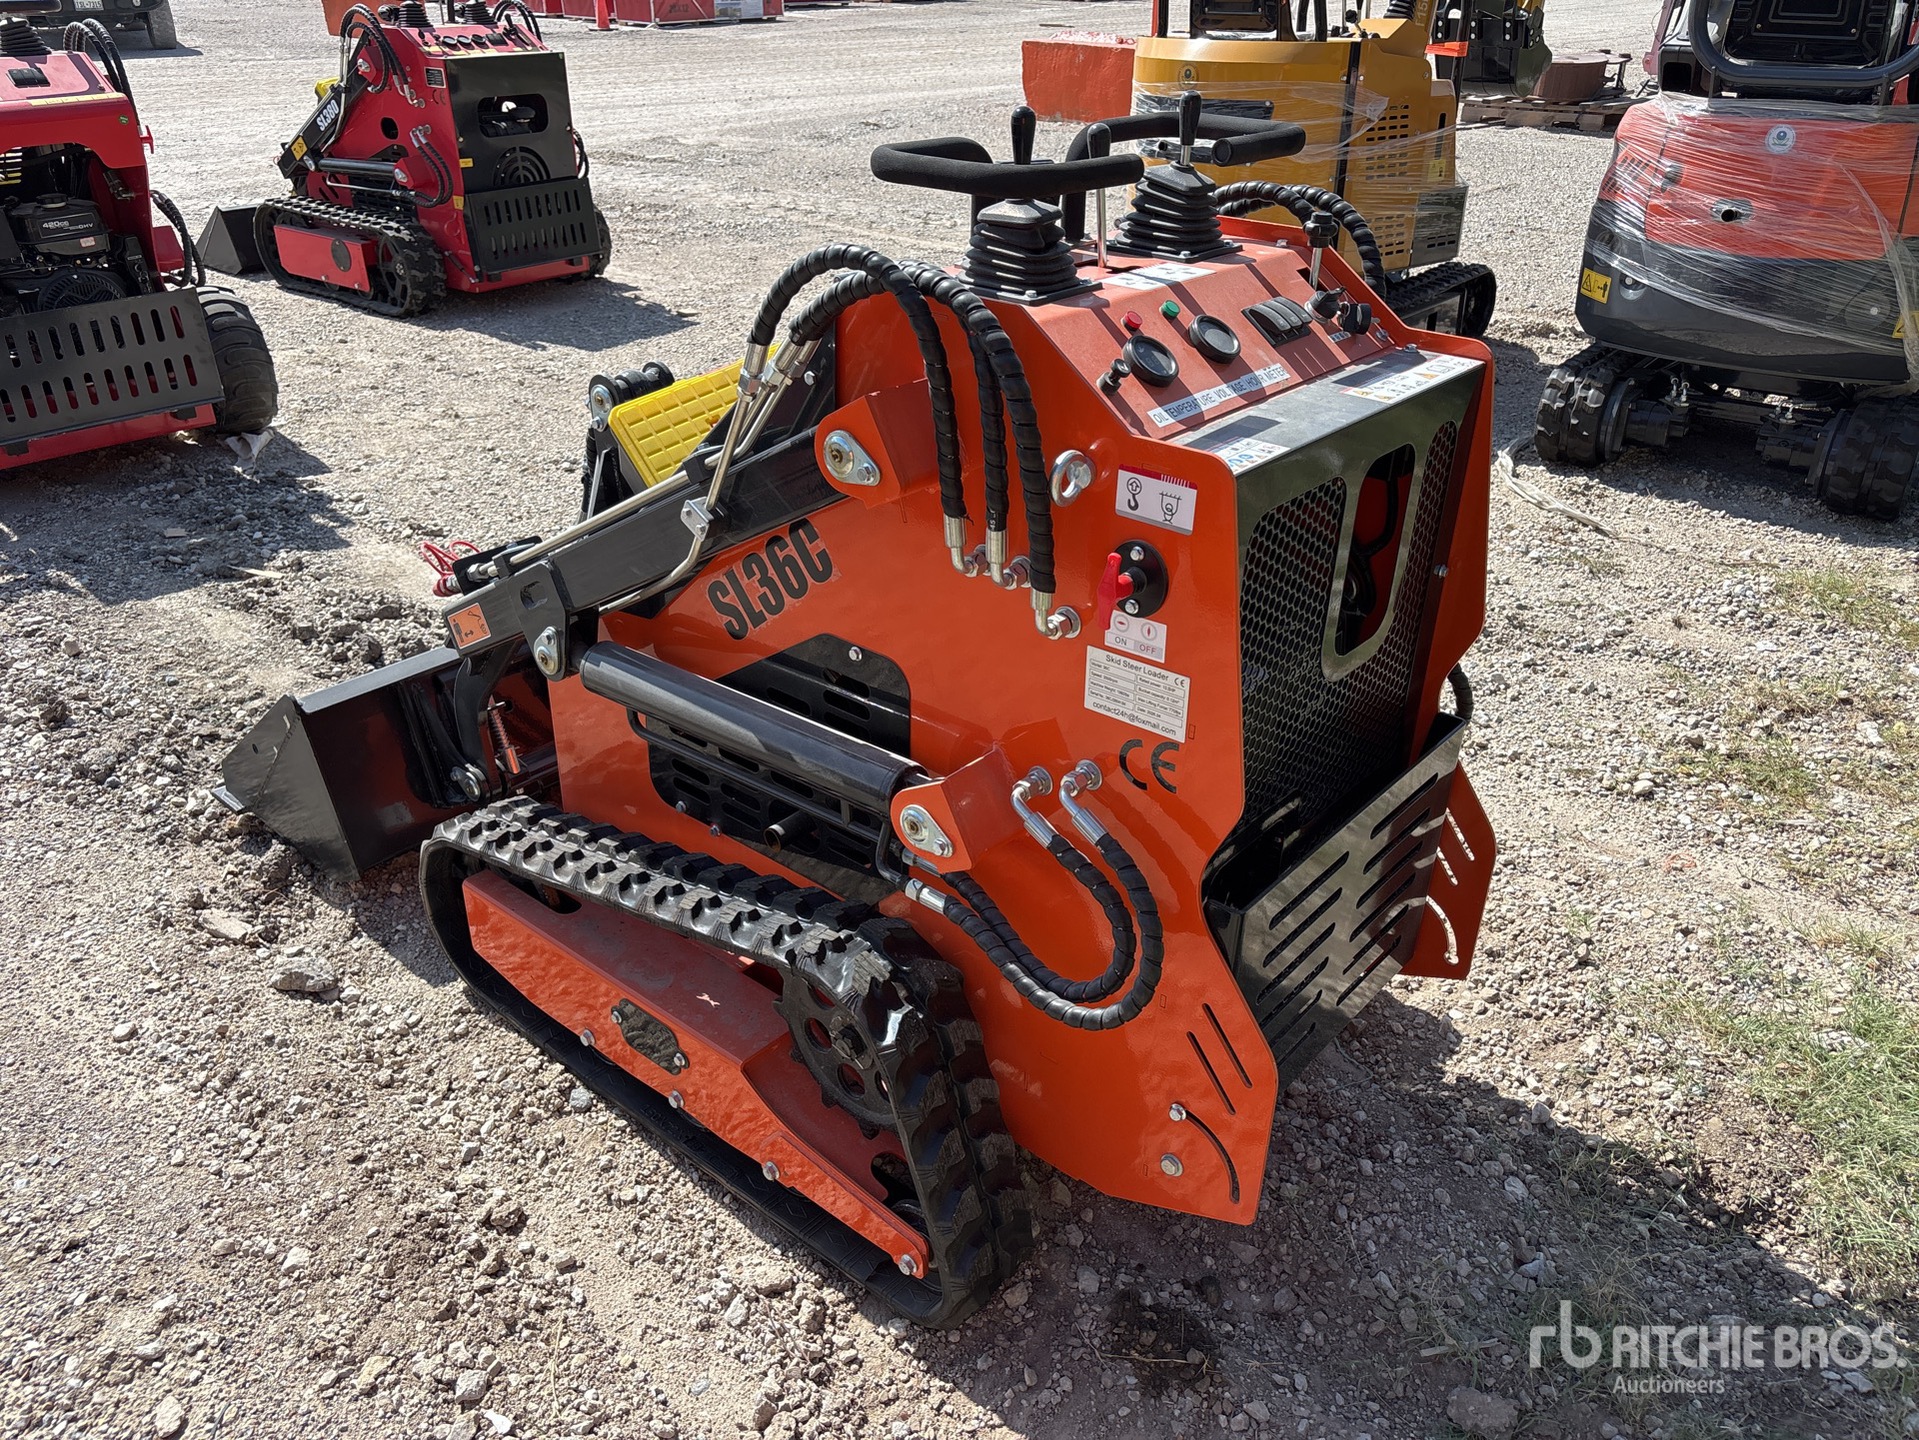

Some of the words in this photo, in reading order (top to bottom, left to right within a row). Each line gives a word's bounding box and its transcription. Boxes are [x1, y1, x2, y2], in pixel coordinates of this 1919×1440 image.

[316, 99, 340, 131] SL380
[1152, 412, 1170, 424] OIL
[1164, 393, 1216, 418] TEMPERATURE
[1215, 381, 1247, 400] VOLTAGE
[1247, 376, 1265, 389] HOUR
[1264, 369, 1288, 381] METER
[707, 517, 833, 641] SL36C
[1114, 636, 1127, 646] ON
[1140, 644, 1157, 655] OFF
[1105, 654, 1121, 666] Skid
[1122, 660, 1142, 672] Steer
[1143, 667, 1169, 680] Loader
[1092, 701, 1177, 736] contact24h@foxmail.com
[1119, 738, 1179, 794] CE
